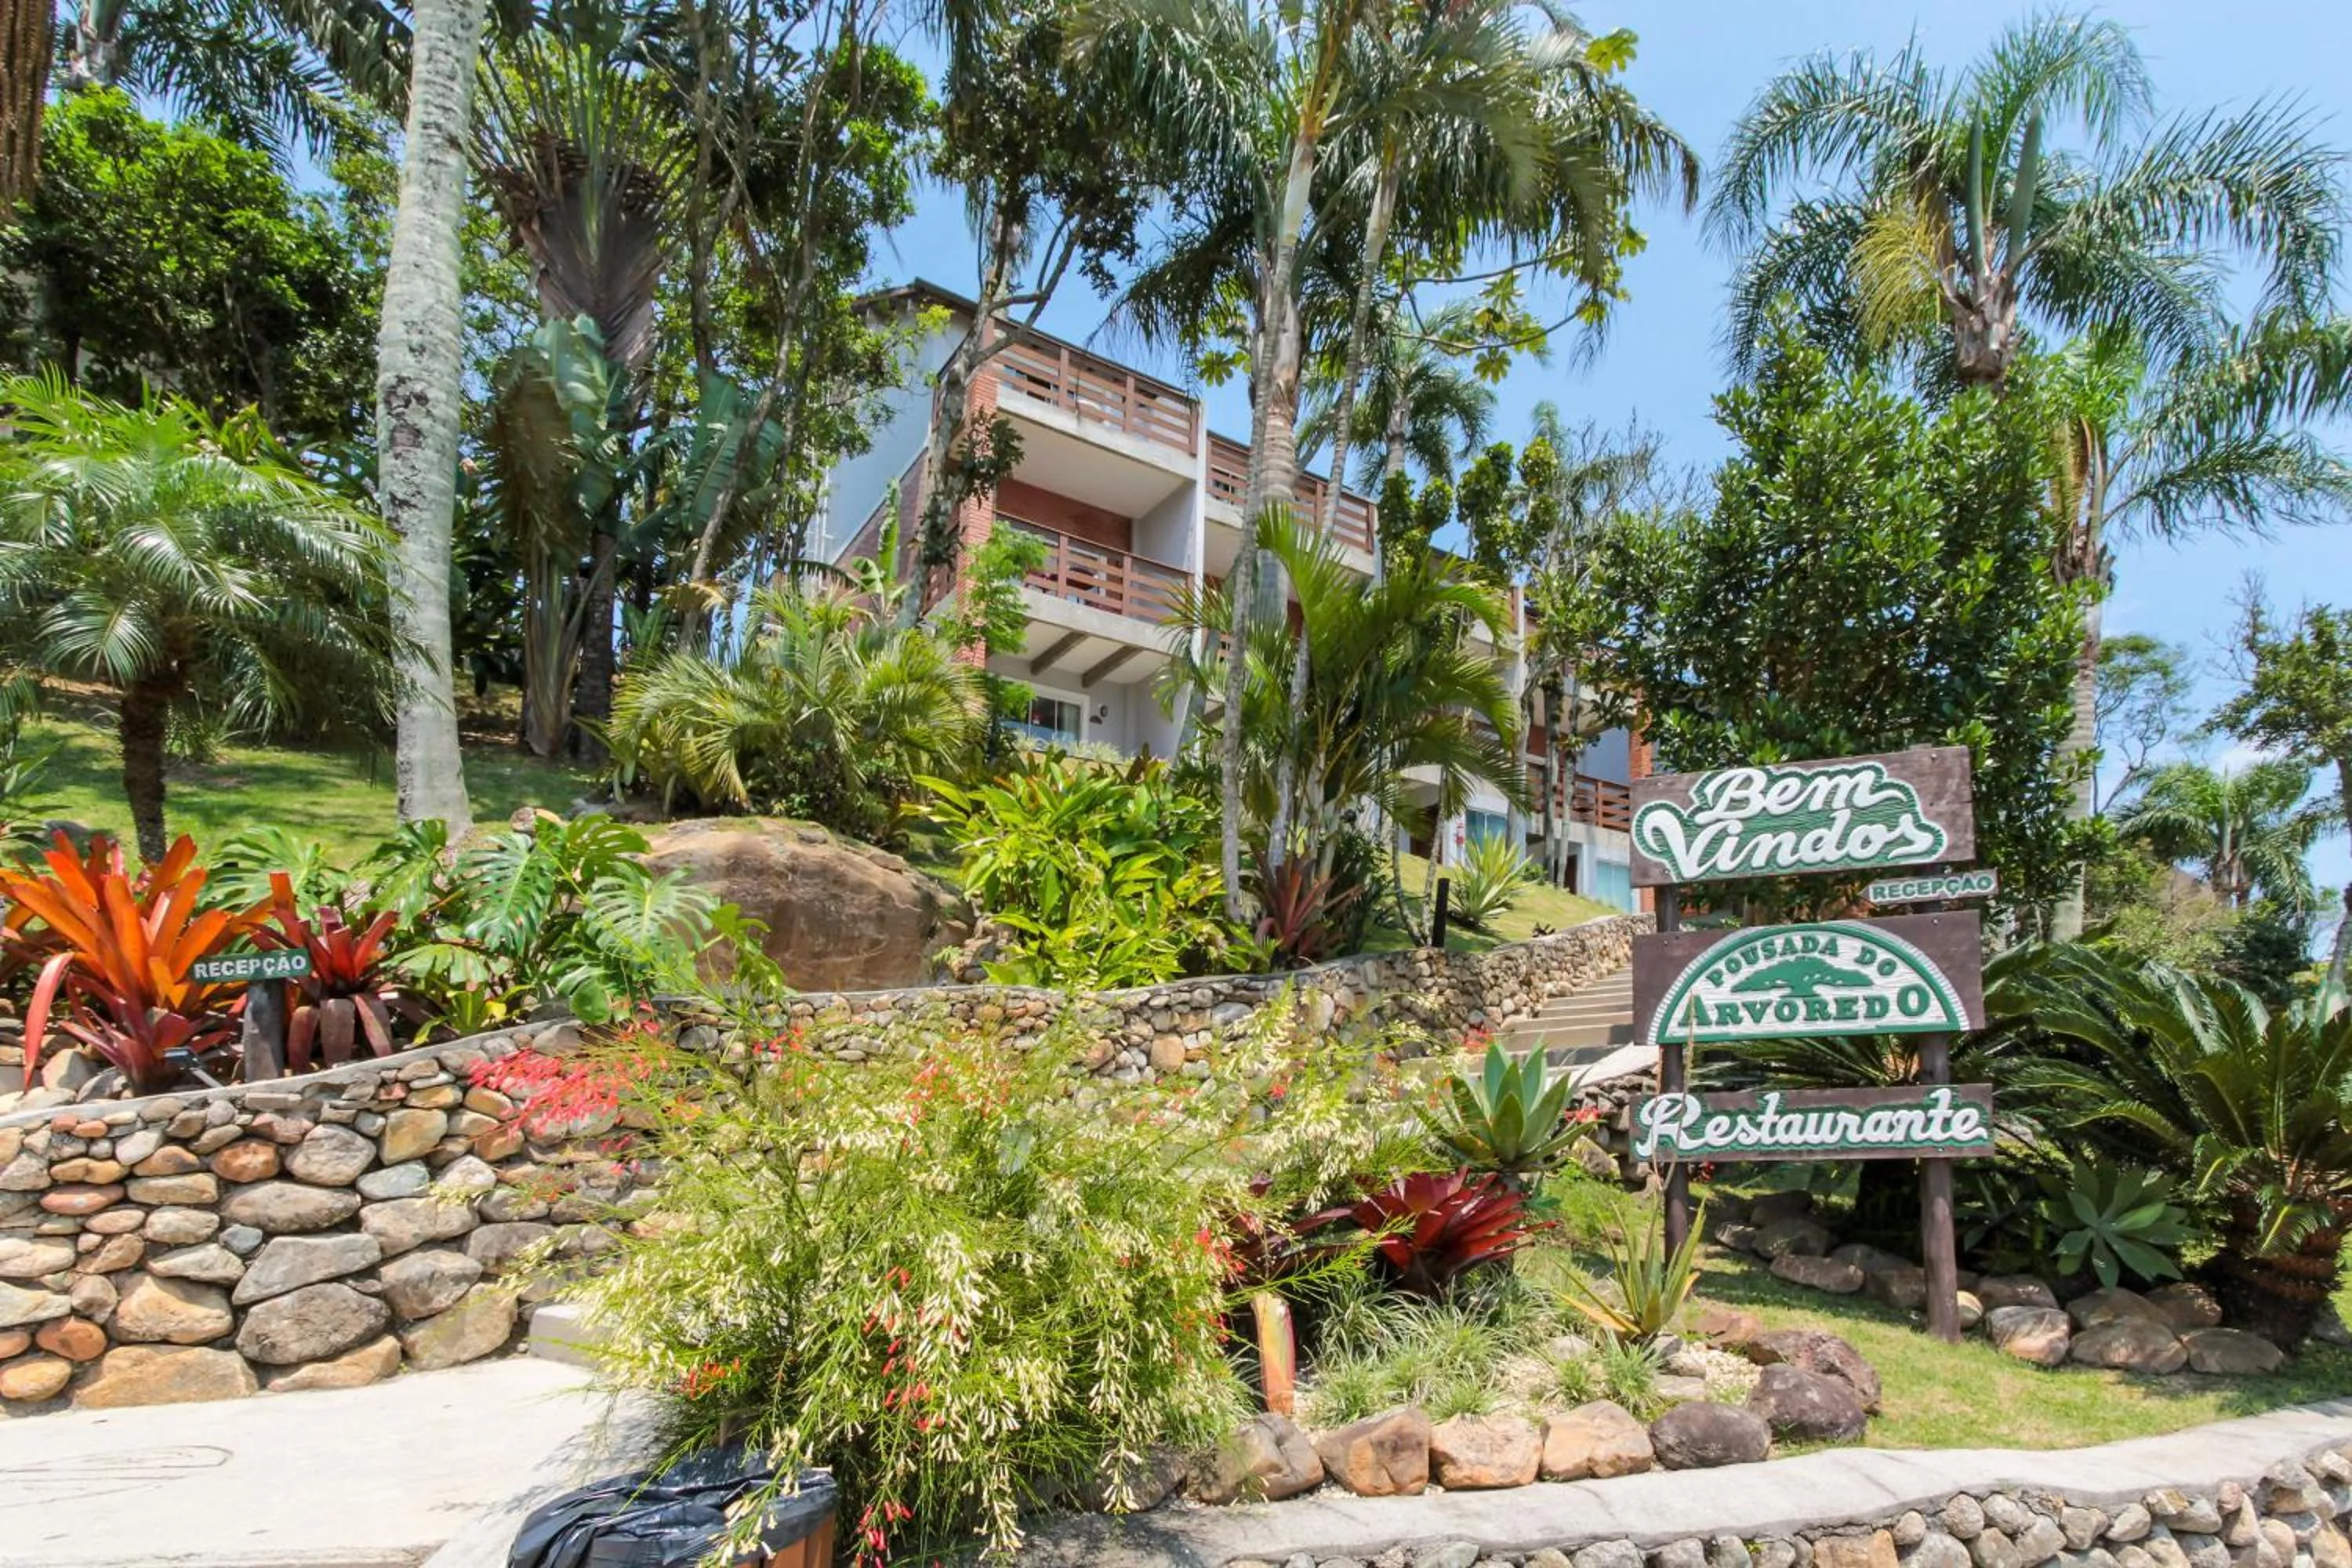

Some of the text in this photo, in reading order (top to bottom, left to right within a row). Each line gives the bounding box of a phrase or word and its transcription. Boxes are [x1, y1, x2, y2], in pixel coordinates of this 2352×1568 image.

[1694, 766, 1907, 825] Bem
[1642, 809, 1935, 880] Vindos
[1704, 935, 1897, 988] POUSADA DO
[1678, 984, 1931, 1027] ARVOREDO
[1635, 1088, 1988, 1158] Restaurante
